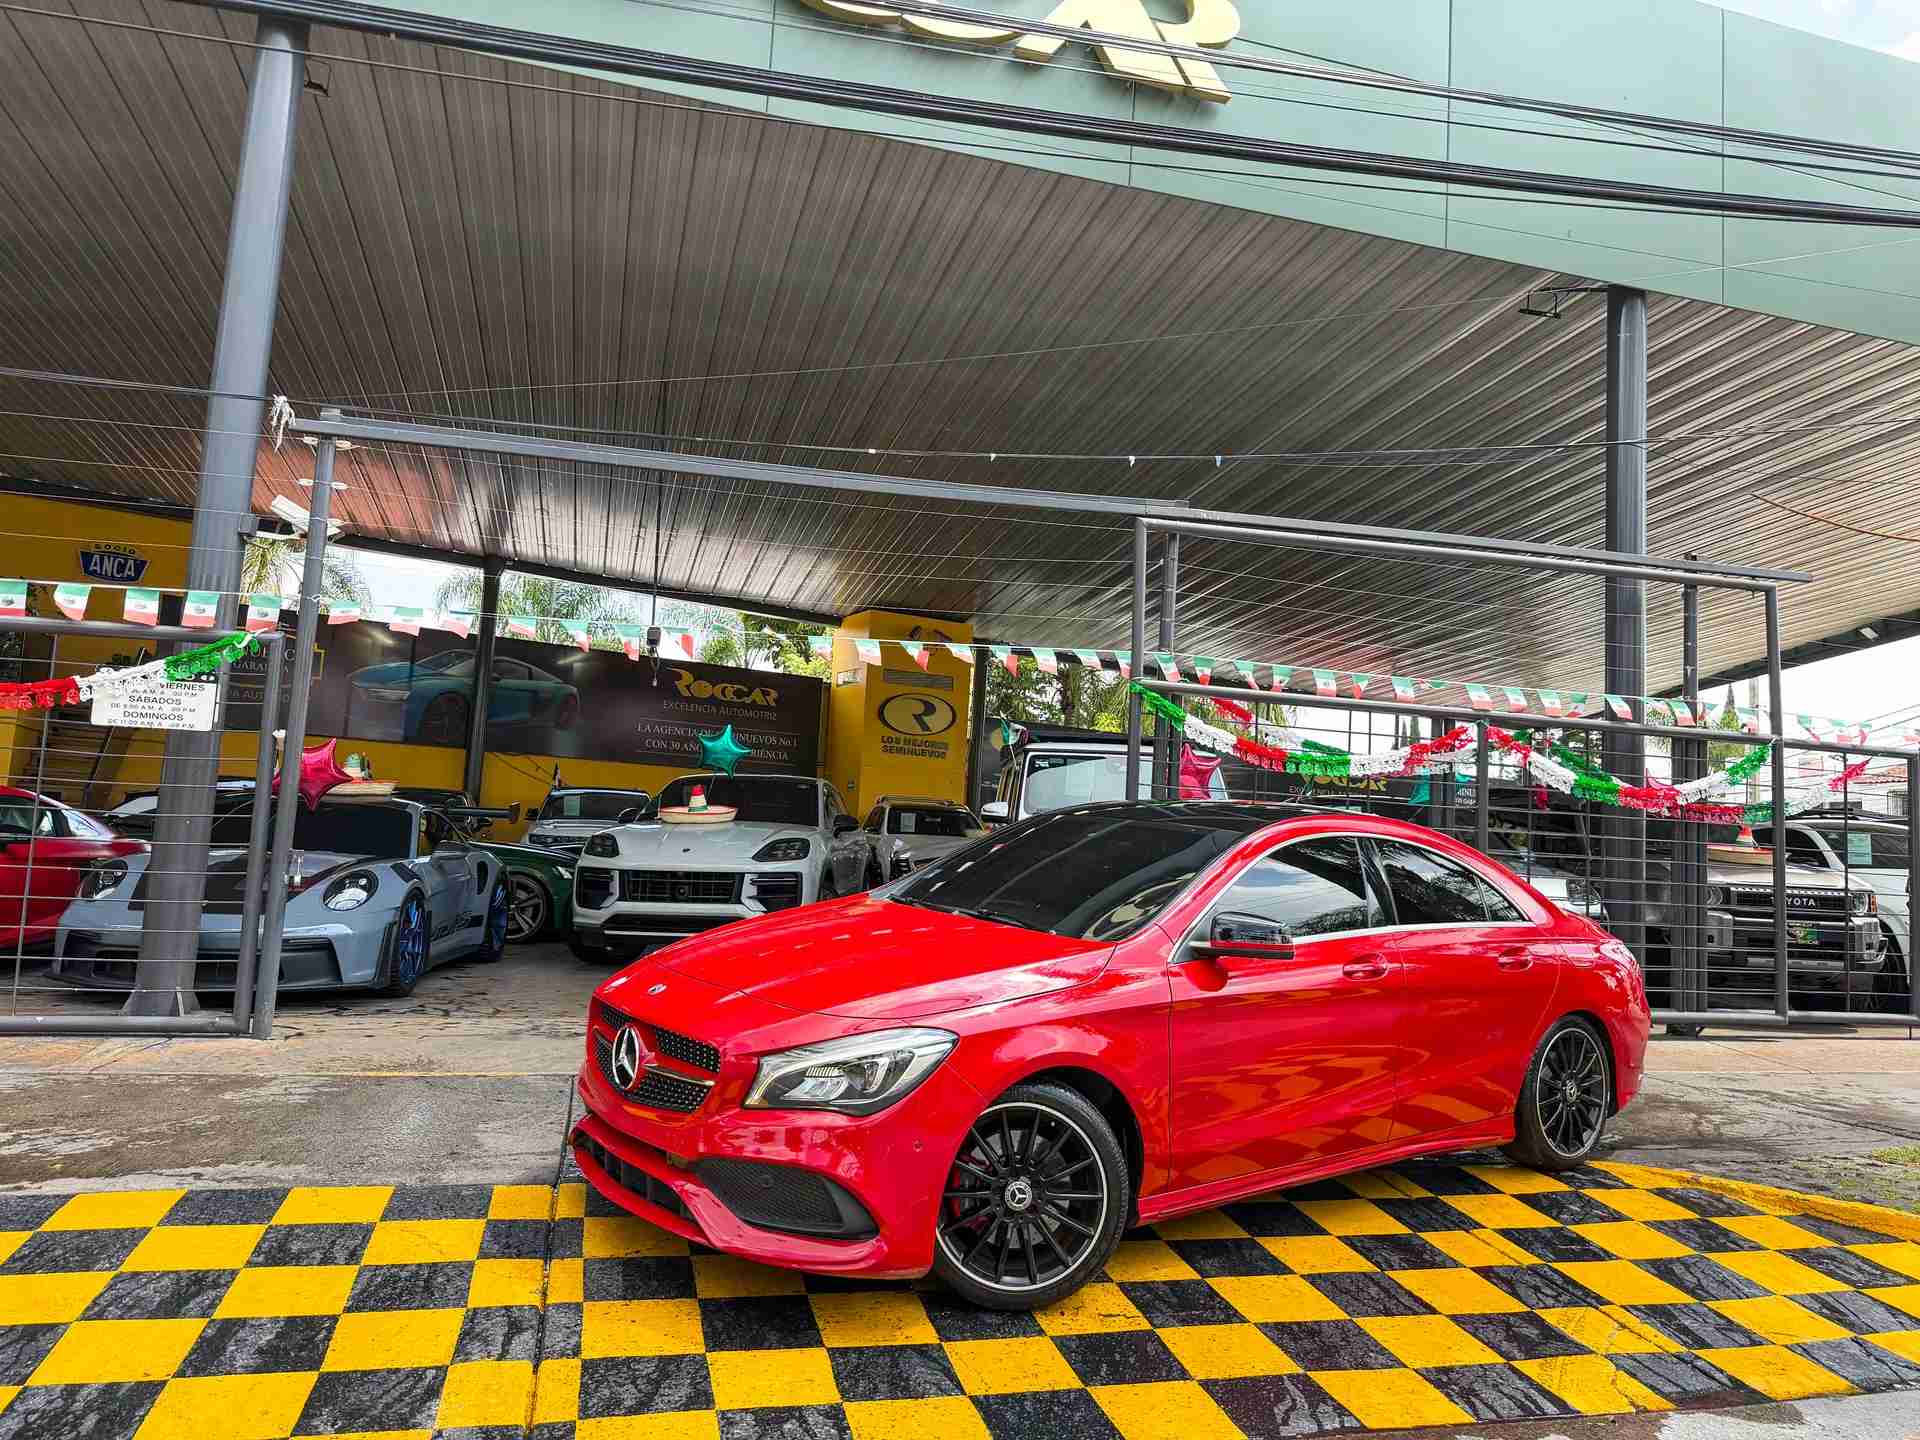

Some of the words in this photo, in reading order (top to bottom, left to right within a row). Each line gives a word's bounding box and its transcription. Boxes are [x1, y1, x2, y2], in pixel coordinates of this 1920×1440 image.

[89, 554, 135, 578] ANCA
[666, 667, 778, 705] ROCCAR
[123, 710, 185, 722] DOMINGOS
[663, 699, 717, 713] EXCELENCIA
[719, 705, 777, 721] AUTOMOTRIZ
[651, 724, 699, 737] AGENCIA
[645, 738, 668, 750] CON
